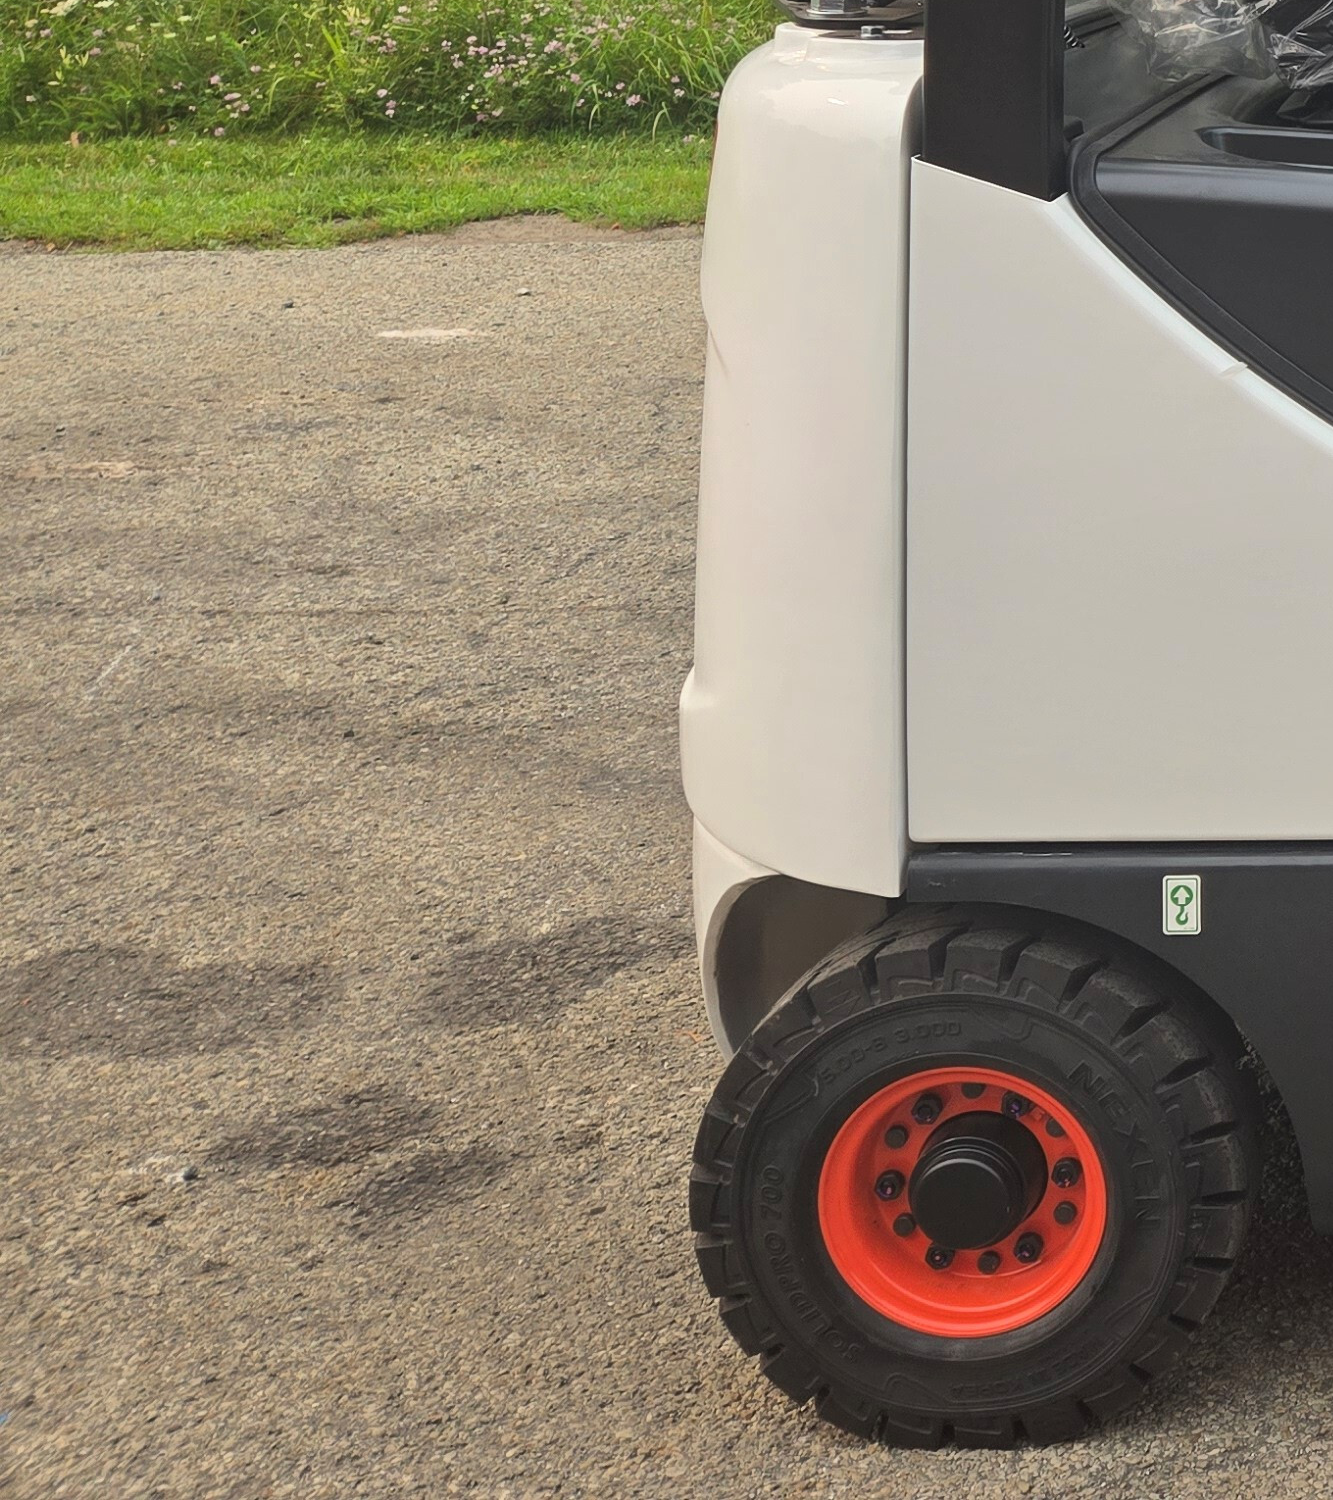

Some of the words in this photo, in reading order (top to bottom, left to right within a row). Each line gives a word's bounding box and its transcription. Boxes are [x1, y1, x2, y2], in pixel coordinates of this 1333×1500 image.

[759, 1165, 785, 1220] 700
[1065, 1060, 1163, 1225] NEXEN
[763, 1235, 867, 1366] SOLIDPRO
